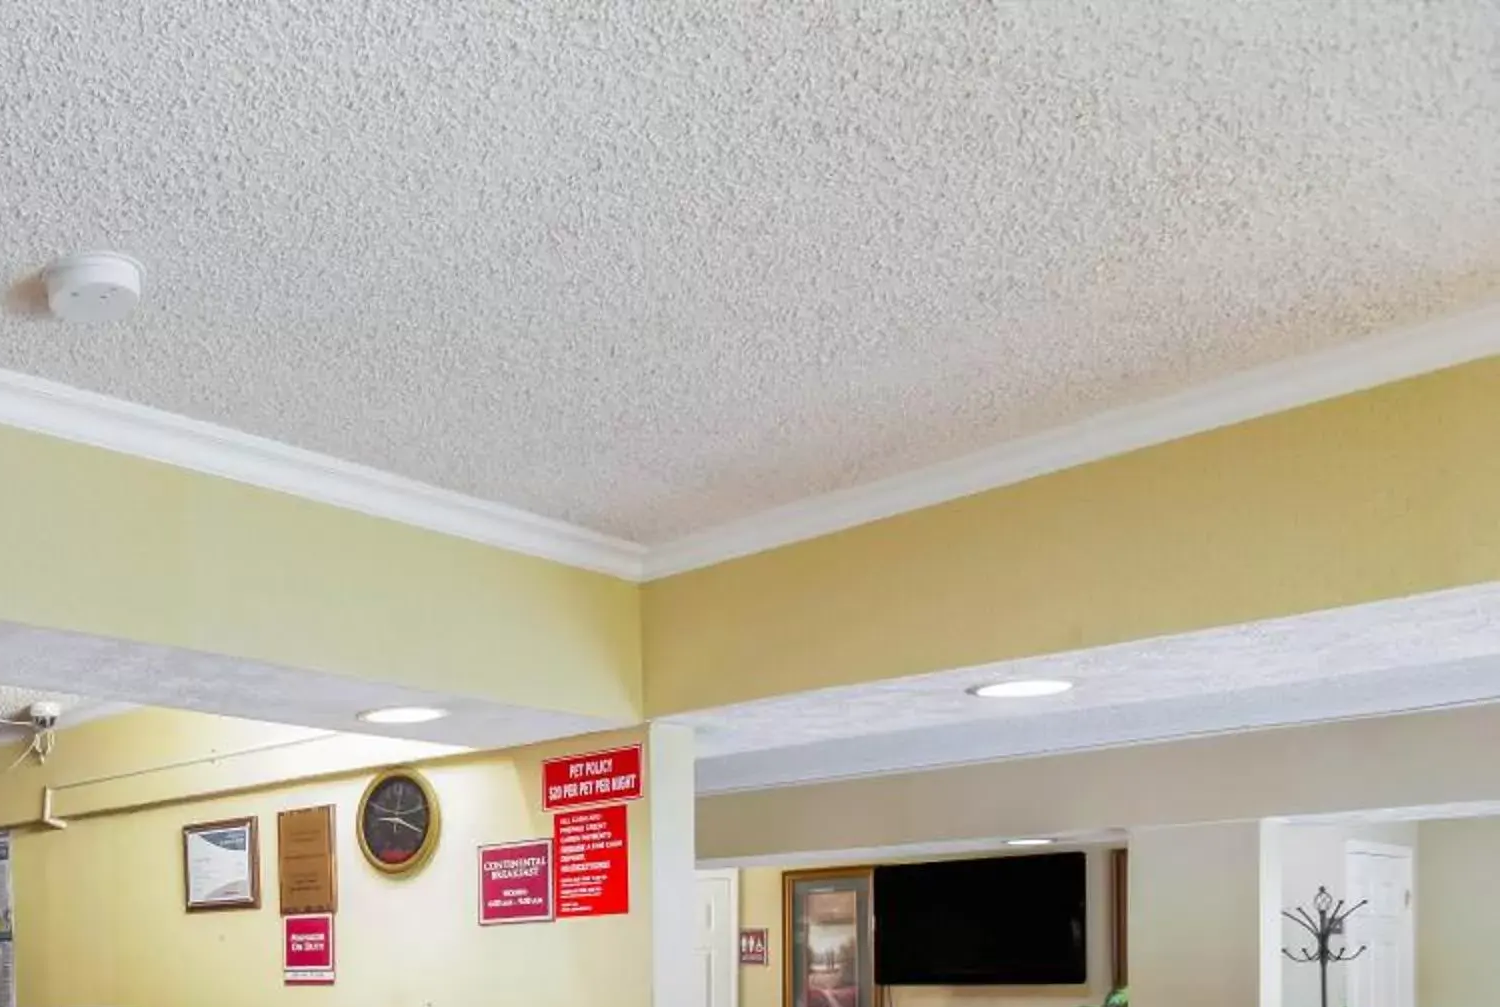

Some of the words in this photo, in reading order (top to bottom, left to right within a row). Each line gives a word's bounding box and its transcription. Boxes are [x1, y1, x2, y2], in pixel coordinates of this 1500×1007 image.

[569, 763, 584, 779] PET
[585, 758, 613, 776] POLICY
[579, 780, 593, 796] PET
[611, 774, 637, 792] NIGHT
